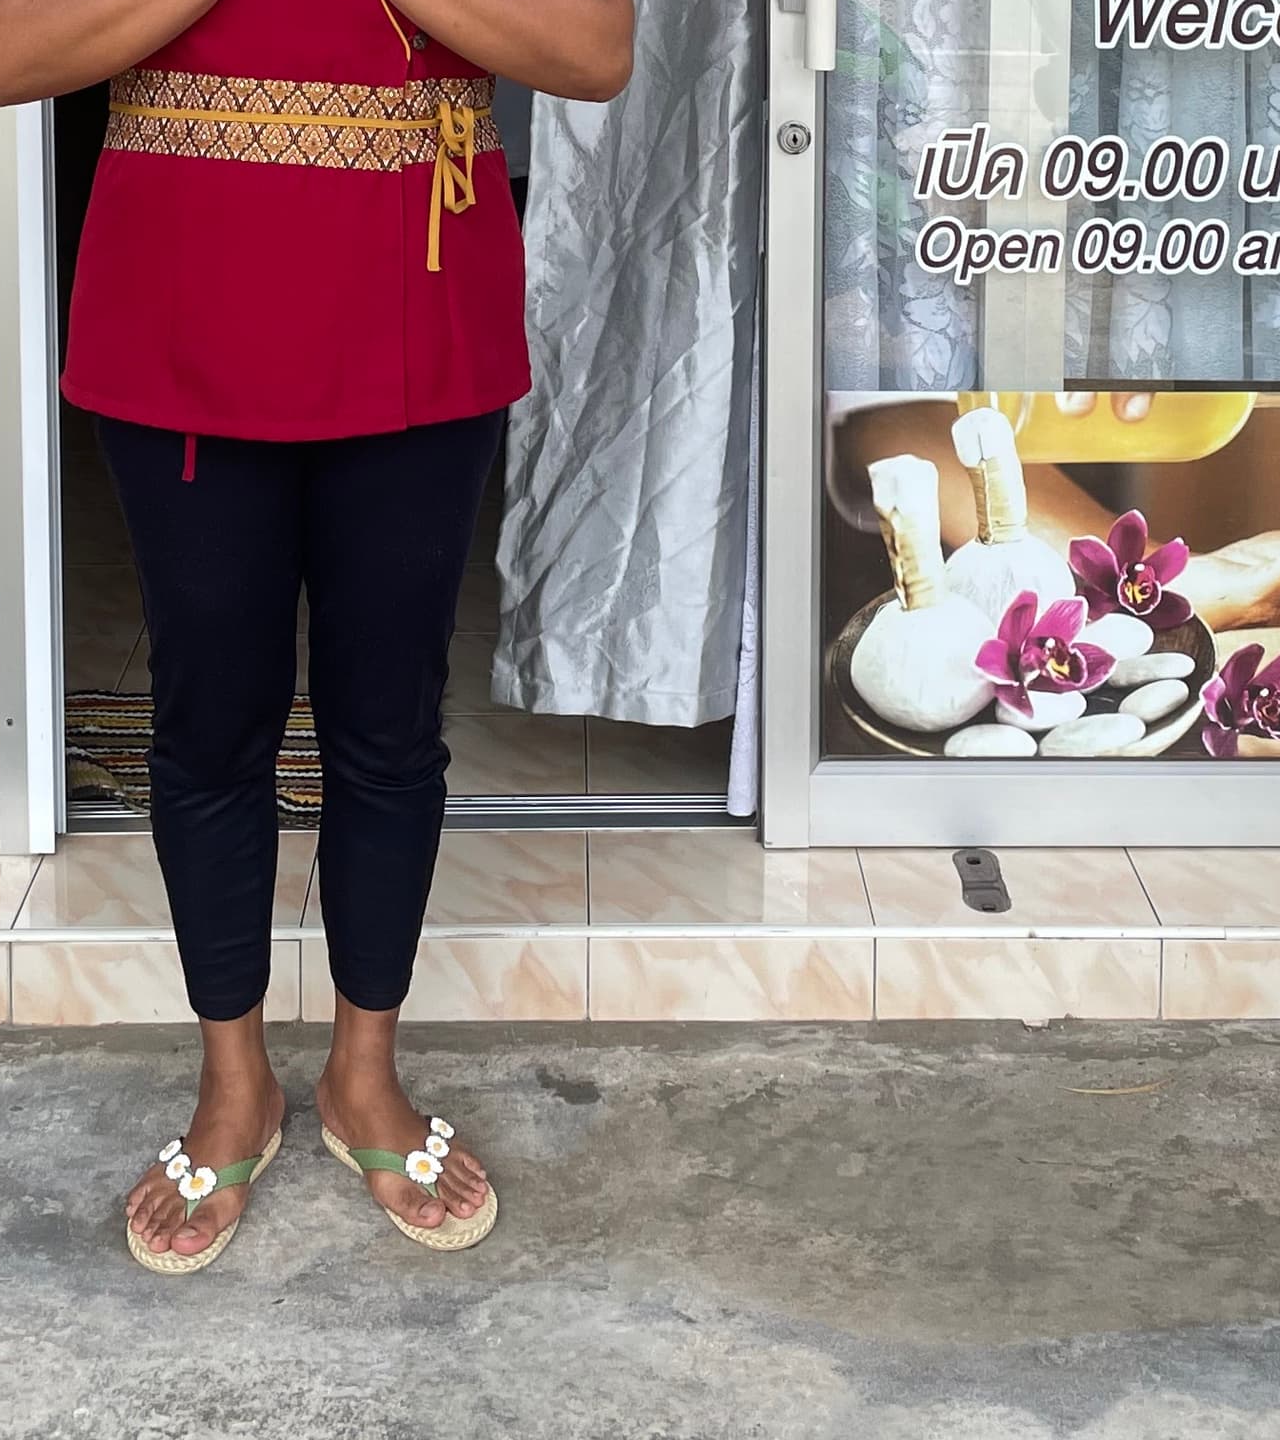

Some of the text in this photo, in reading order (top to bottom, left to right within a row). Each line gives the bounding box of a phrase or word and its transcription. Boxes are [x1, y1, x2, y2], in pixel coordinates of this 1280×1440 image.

[917, 127, 1025, 197] เปิด
[1044, 140, 1226, 199] 09.00
[919, 220, 1061, 281] Open
[1076, 223, 1226, 271] 09.00
